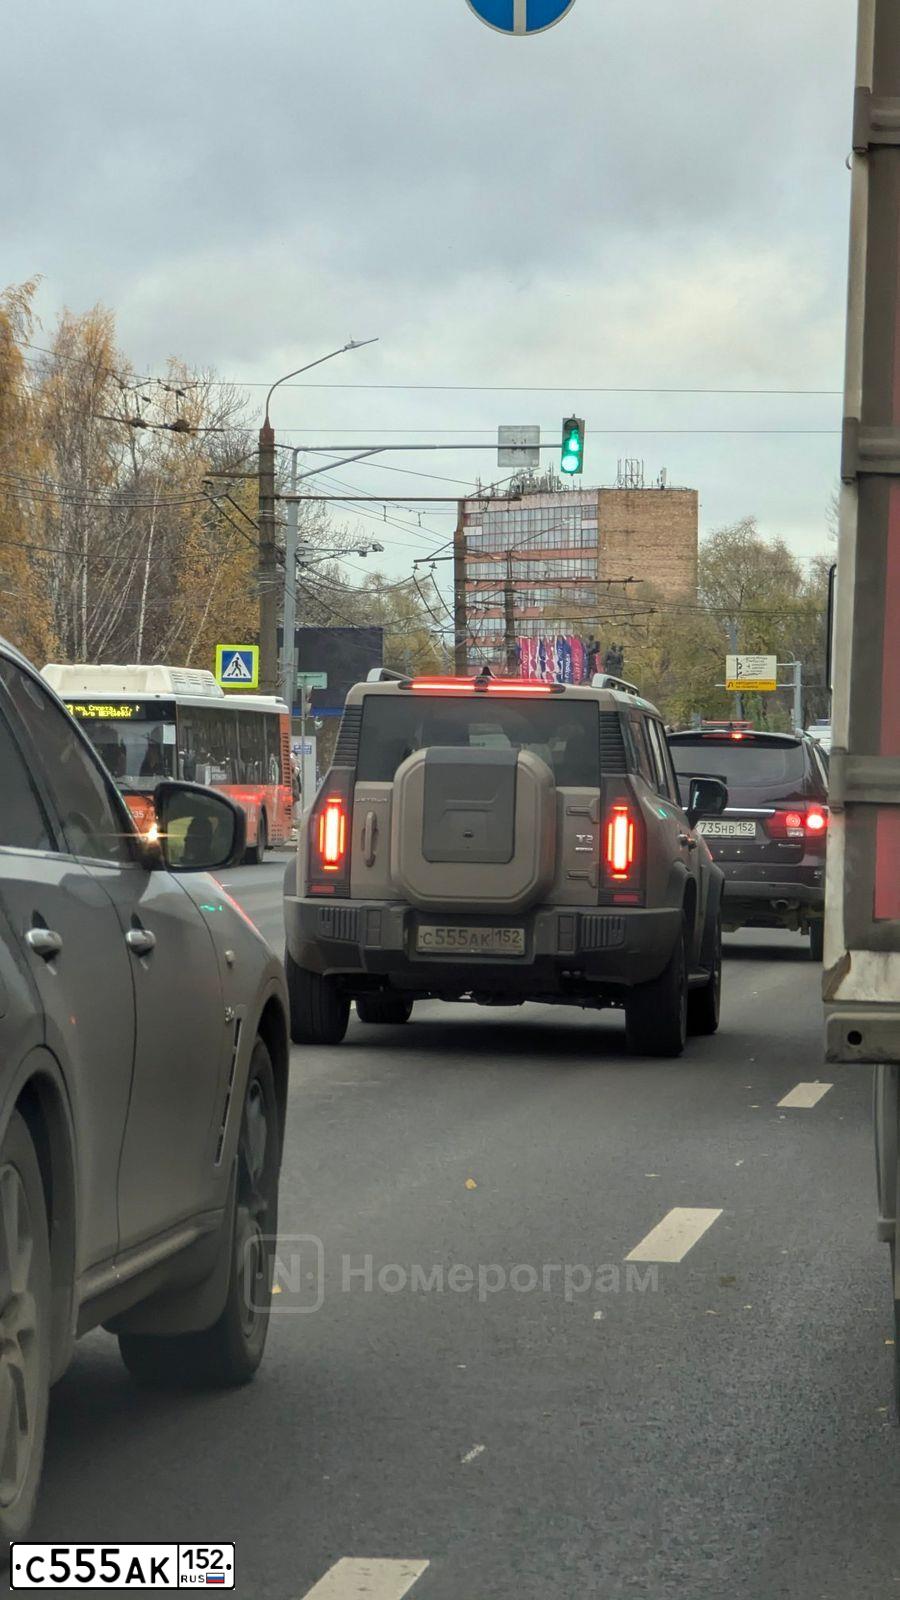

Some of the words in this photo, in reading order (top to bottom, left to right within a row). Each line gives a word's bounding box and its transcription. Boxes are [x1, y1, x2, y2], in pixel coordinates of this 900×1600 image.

[701, 822, 735, 834] 735НВ
[738, 823, 754, 832] 152
[422, 928, 491, 946] С555АК
[495, 929, 520, 944] 152
